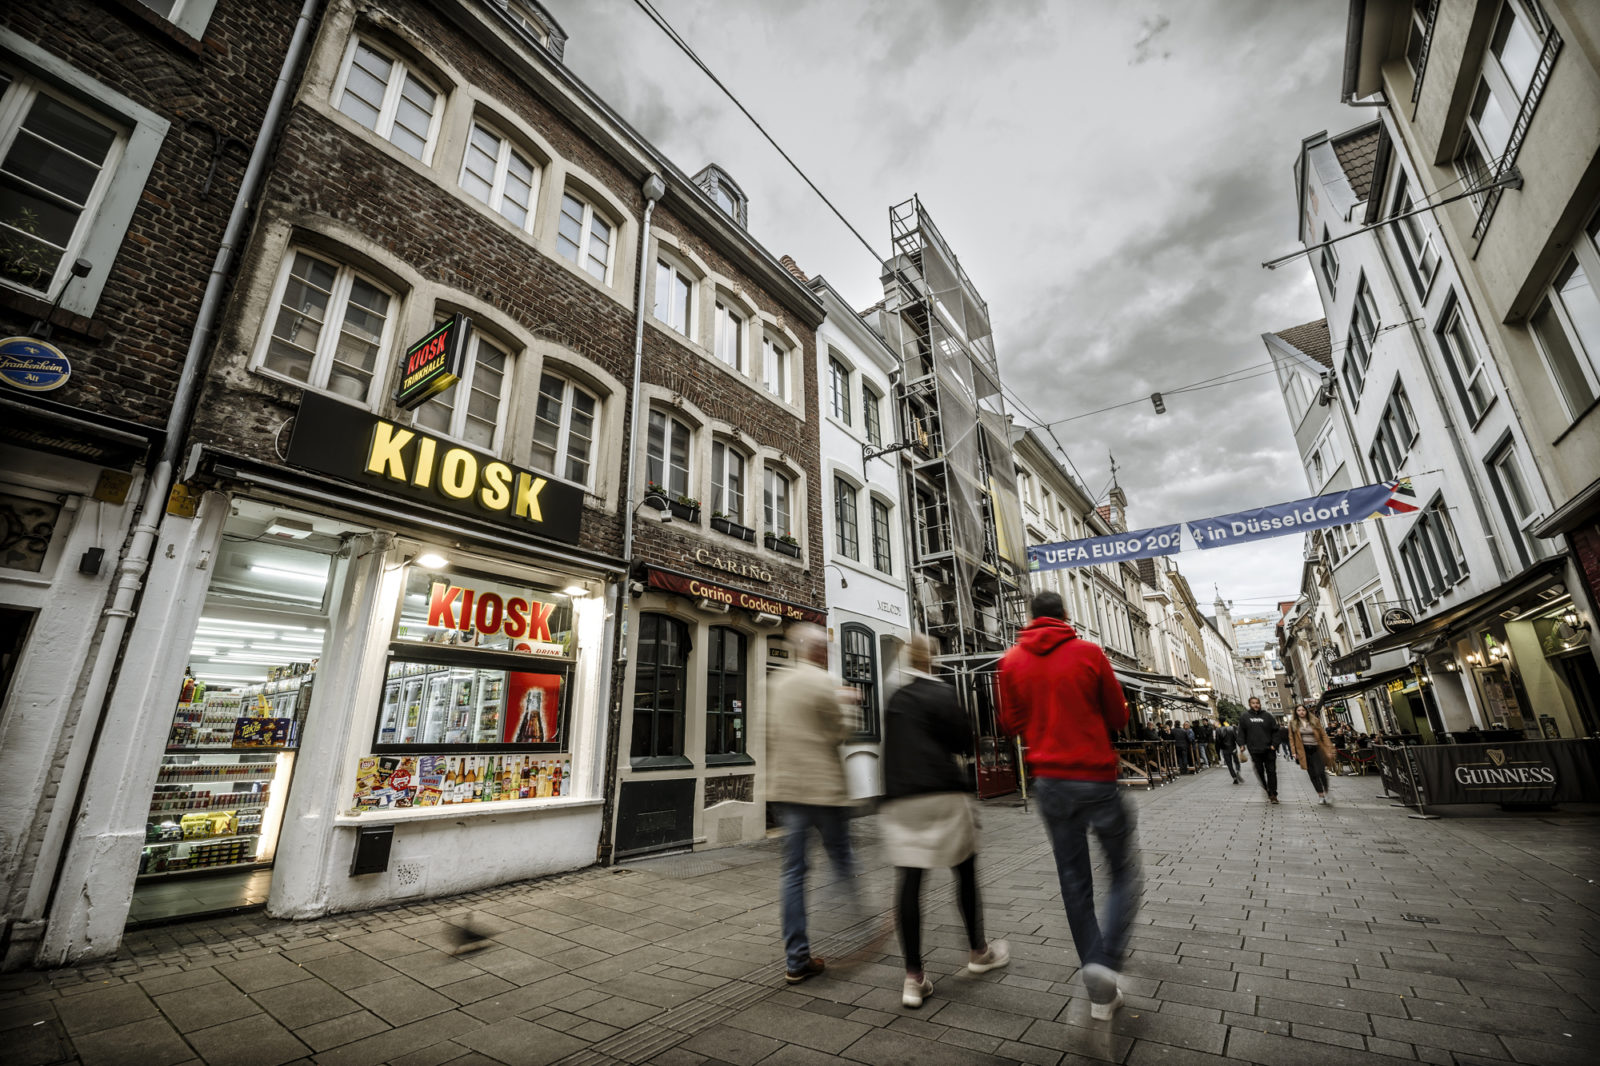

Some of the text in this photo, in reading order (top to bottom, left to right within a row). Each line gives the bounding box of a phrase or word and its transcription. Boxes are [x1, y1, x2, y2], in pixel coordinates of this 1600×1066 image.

[403, 353, 446, 390] TRINKHALLE
[407, 331, 448, 376] KIOSK
[24, 373, 40, 383] Alt
[365, 420, 548, 523] KIOSK
[1045, 546, 1089, 564] UEFA
[1092, 538, 1142, 557] EURO
[1208, 526, 1227, 541] in
[1233, 499, 1350, 537] Düsseldorf
[695, 548, 772, 583] CARIÑO
[427, 582, 556, 643] KIOSK
[689, 580, 804, 620] Cariño Cocktail Bar
[536, 648, 560, 656] DRINK
[1455, 766, 1554, 785] GUINNESS
